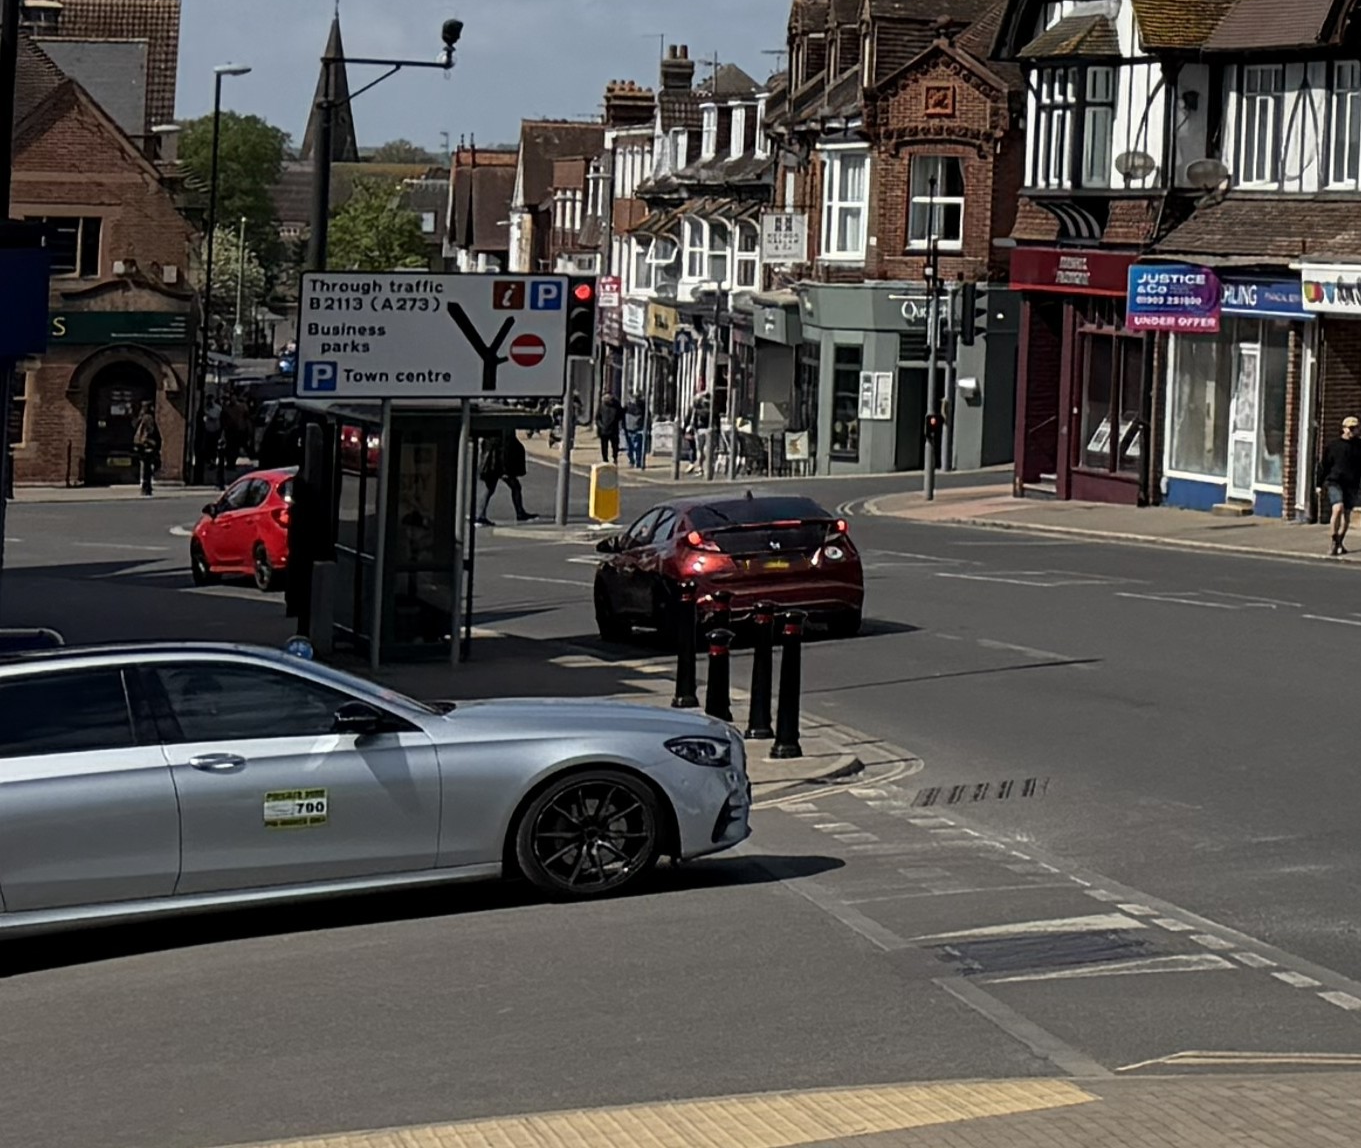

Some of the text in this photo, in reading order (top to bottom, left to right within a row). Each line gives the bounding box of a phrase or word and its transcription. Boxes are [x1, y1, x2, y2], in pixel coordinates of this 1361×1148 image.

[309, 279, 444, 294] Through traffic
[1137, 273, 1206, 285] JUSTICE
[307, 322, 386, 337] Business
[1133, 315, 1216, 329] UNDER OFFER
[320, 340, 371, 355] parks
[343, 368, 389, 383] Town
[395, 368, 452, 383] centre
